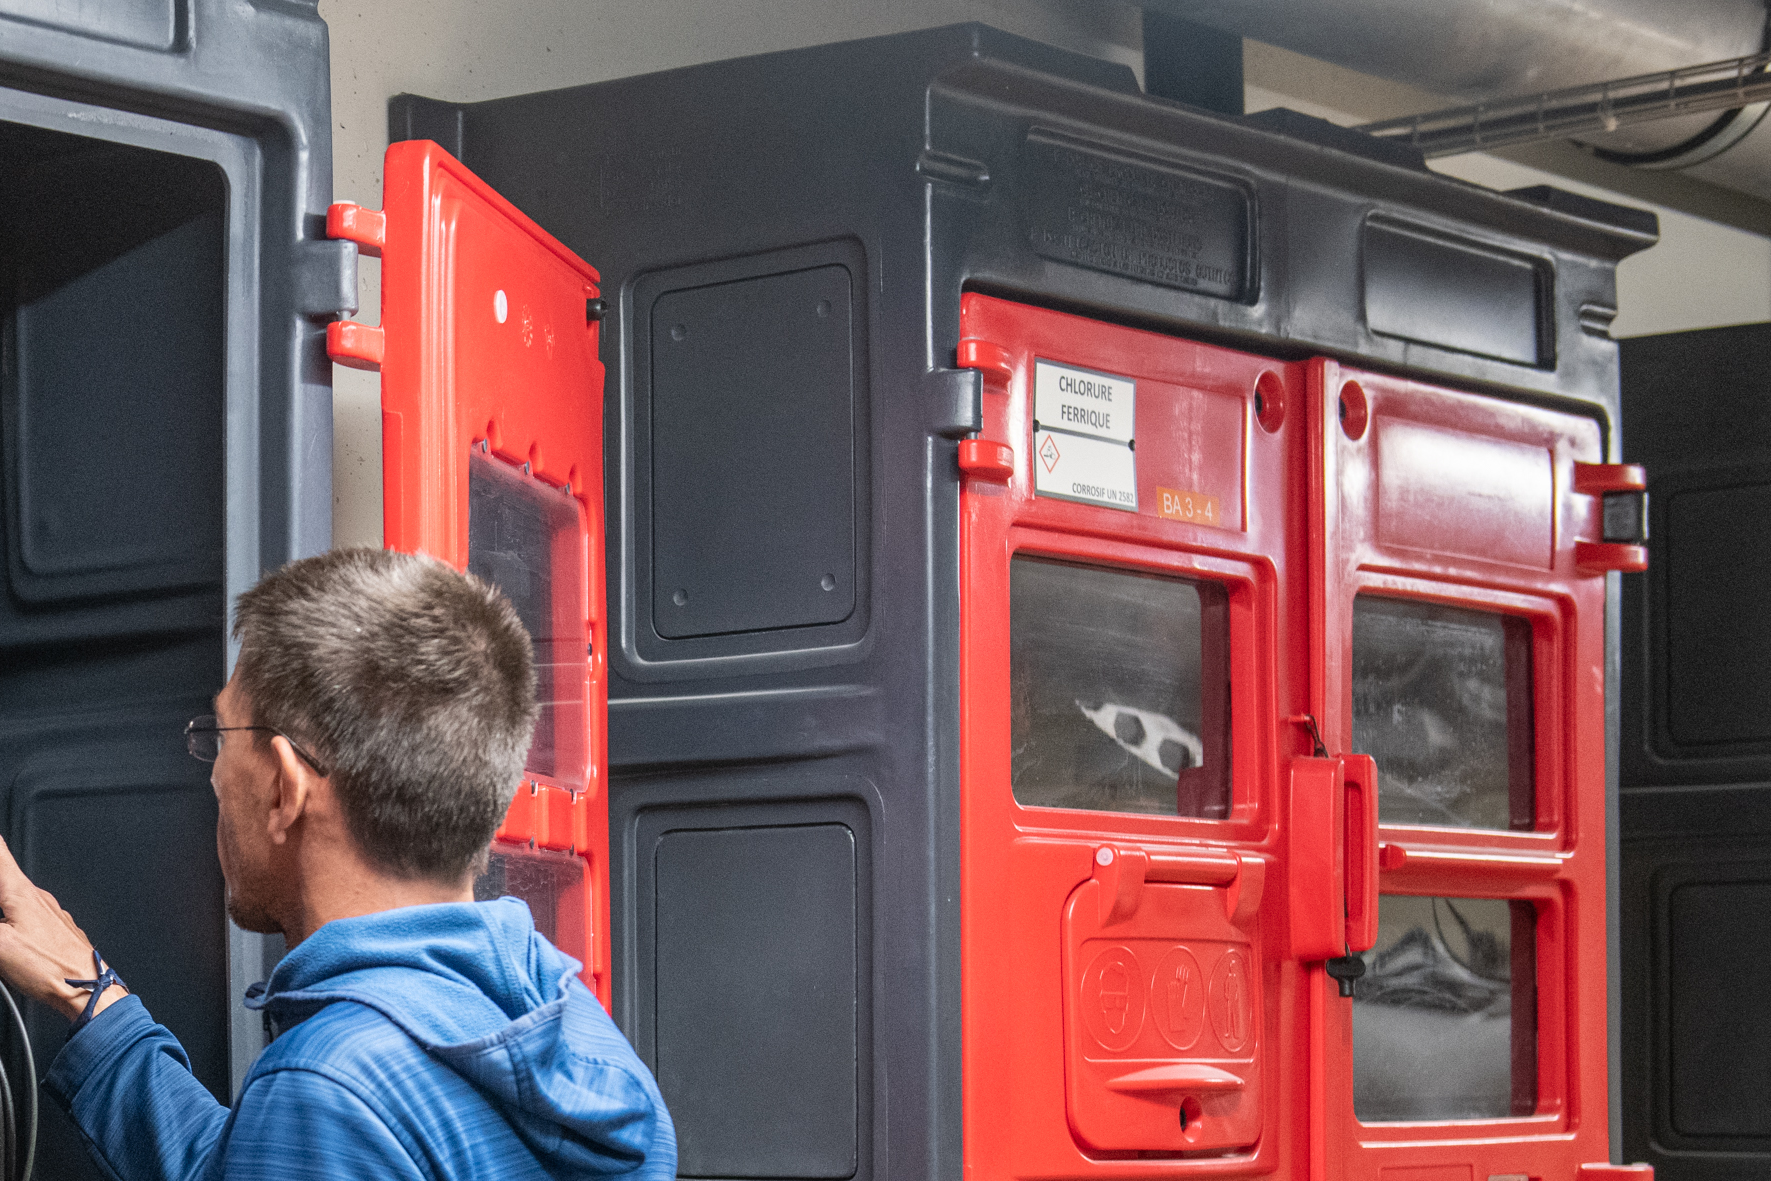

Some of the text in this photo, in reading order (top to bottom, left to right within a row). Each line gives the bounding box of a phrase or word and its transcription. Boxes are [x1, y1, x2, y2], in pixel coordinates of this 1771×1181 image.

[1059, 376, 1113, 402] CHLORURE
[1061, 404, 1111, 429] FERRIQUE
[1072, 482, 1134, 504] CORROSIF UN 2582
[1163, 492, 1183, 516] BA
[1185, 498, 1194, 517] 3
[1204, 501, 1213, 521] 4
